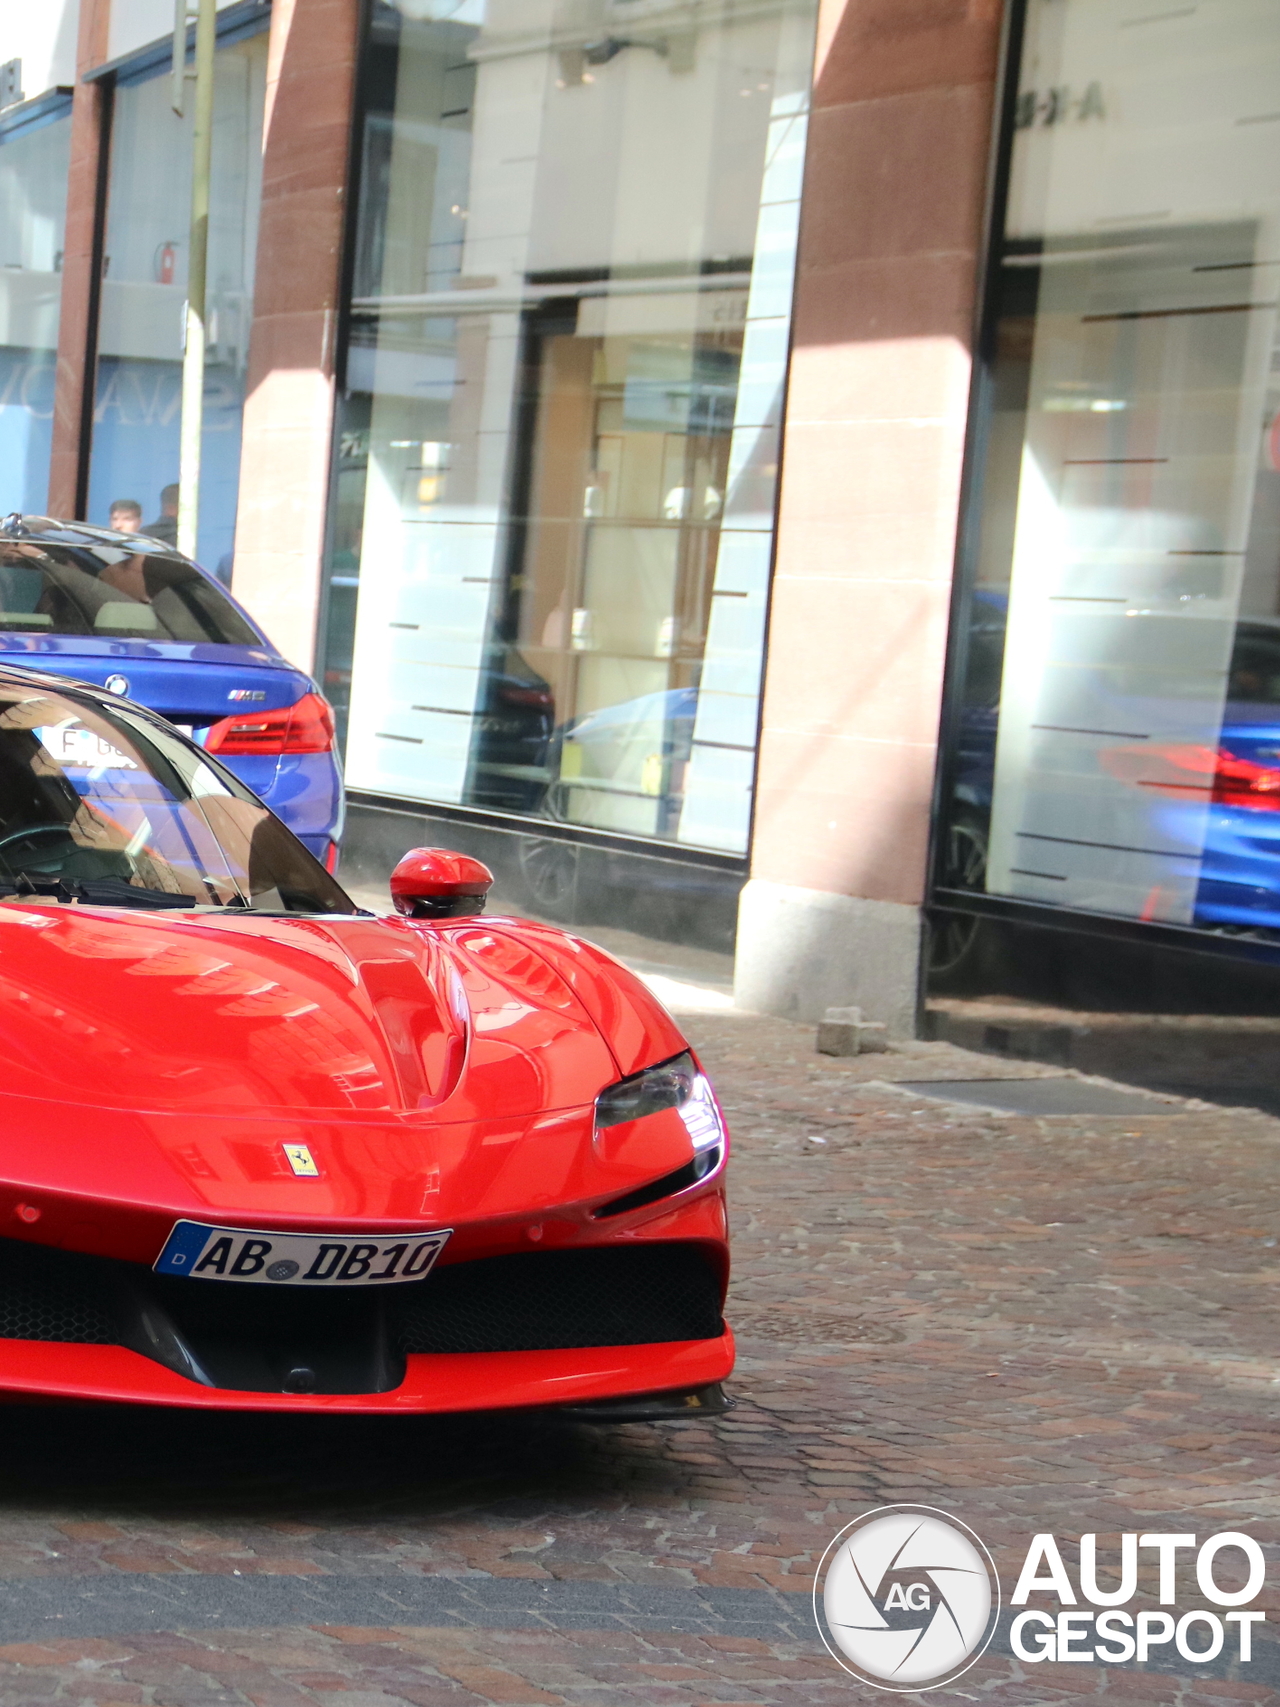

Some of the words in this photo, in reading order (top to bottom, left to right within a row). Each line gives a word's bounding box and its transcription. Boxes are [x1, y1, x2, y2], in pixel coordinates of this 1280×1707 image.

[171, 1253, 187, 1265] D
[194, 1237, 273, 1276] AB
[302, 1240, 441, 1281] DB10
